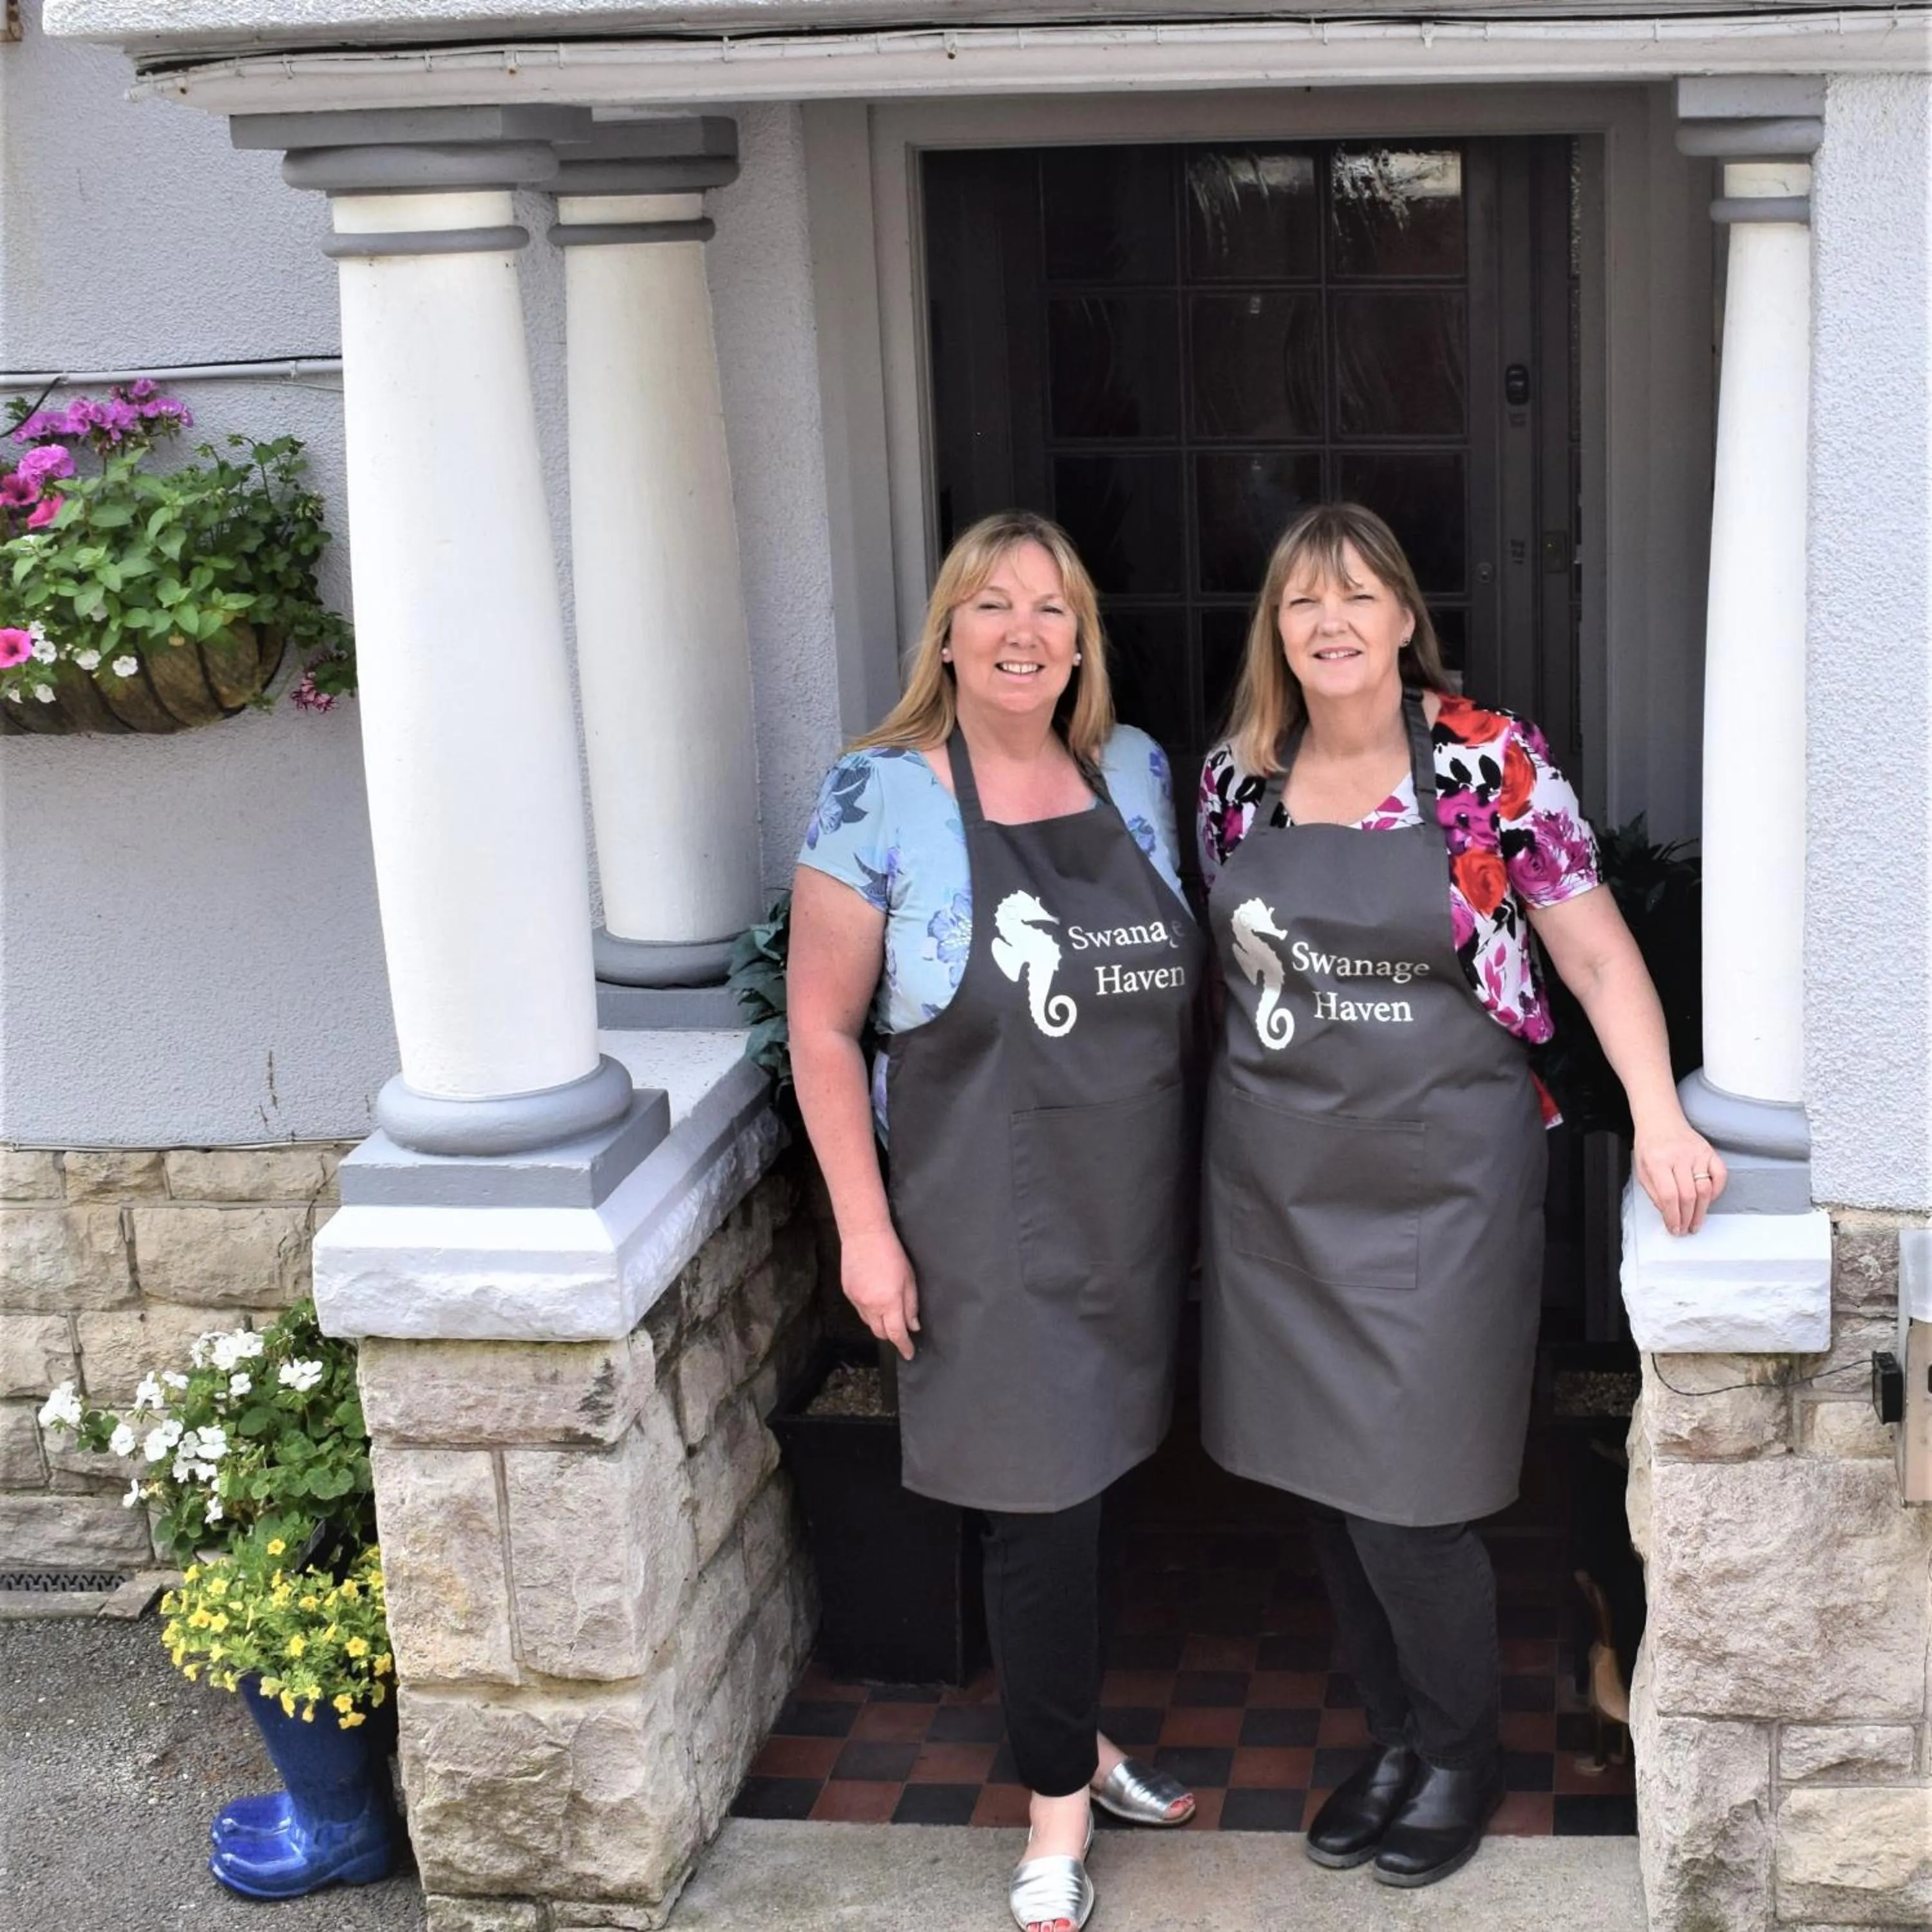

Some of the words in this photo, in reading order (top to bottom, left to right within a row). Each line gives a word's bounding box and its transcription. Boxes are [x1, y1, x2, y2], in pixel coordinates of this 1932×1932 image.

[1068, 920, 1184, 951] Swanae
[1291, 941, 1430, 983] Swanage
[1094, 965, 1186, 996] Haven
[1312, 991, 1414, 1022] Haven
